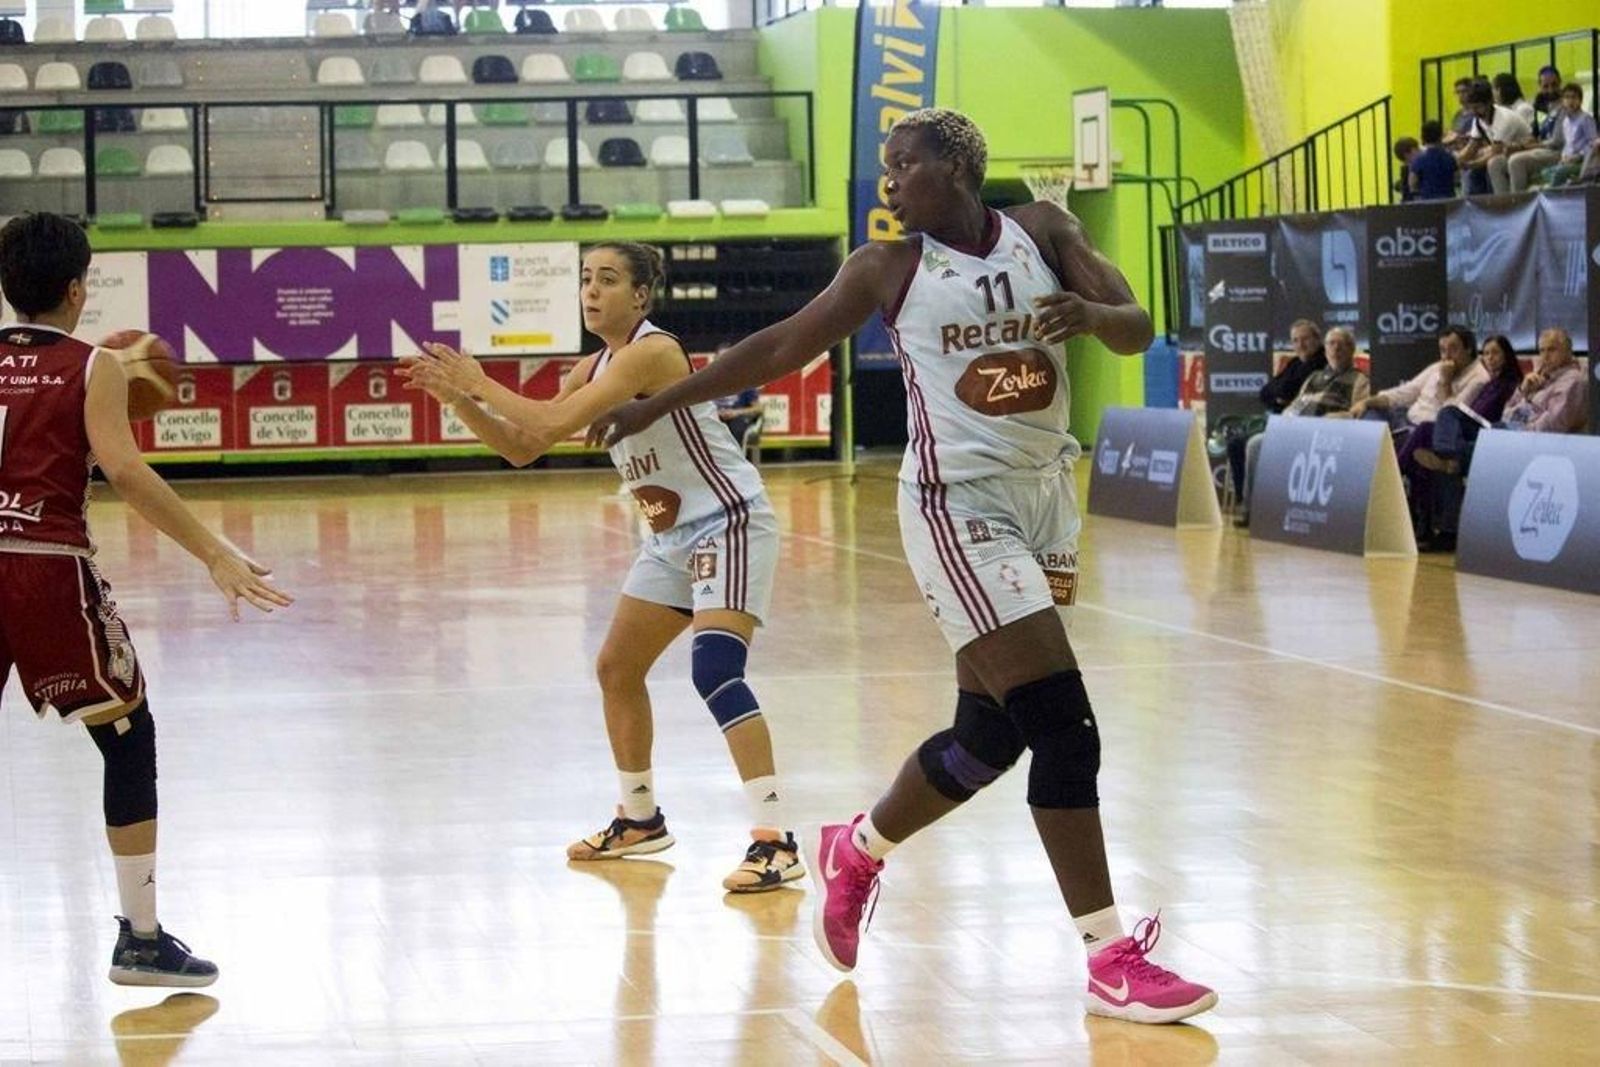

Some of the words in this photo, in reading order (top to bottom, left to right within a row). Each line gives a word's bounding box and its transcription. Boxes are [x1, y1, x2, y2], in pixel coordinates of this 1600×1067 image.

[974, 271, 1015, 314] 11
[940, 316, 1033, 355] Recal
[0, 355, 38, 368] ATI
[977, 363, 1048, 402] Zorka
[157, 412, 218, 426] Concello
[252, 409, 313, 423] Concello
[347, 407, 408, 421] Concello
[161, 430, 177, 442] de
[180, 429, 211, 444] Vigo
[257, 427, 272, 439] de
[276, 426, 306, 442] Vigo
[352, 424, 367, 436] de
[371, 424, 402, 438] Vigo
[626, 447, 661, 481] alvi
